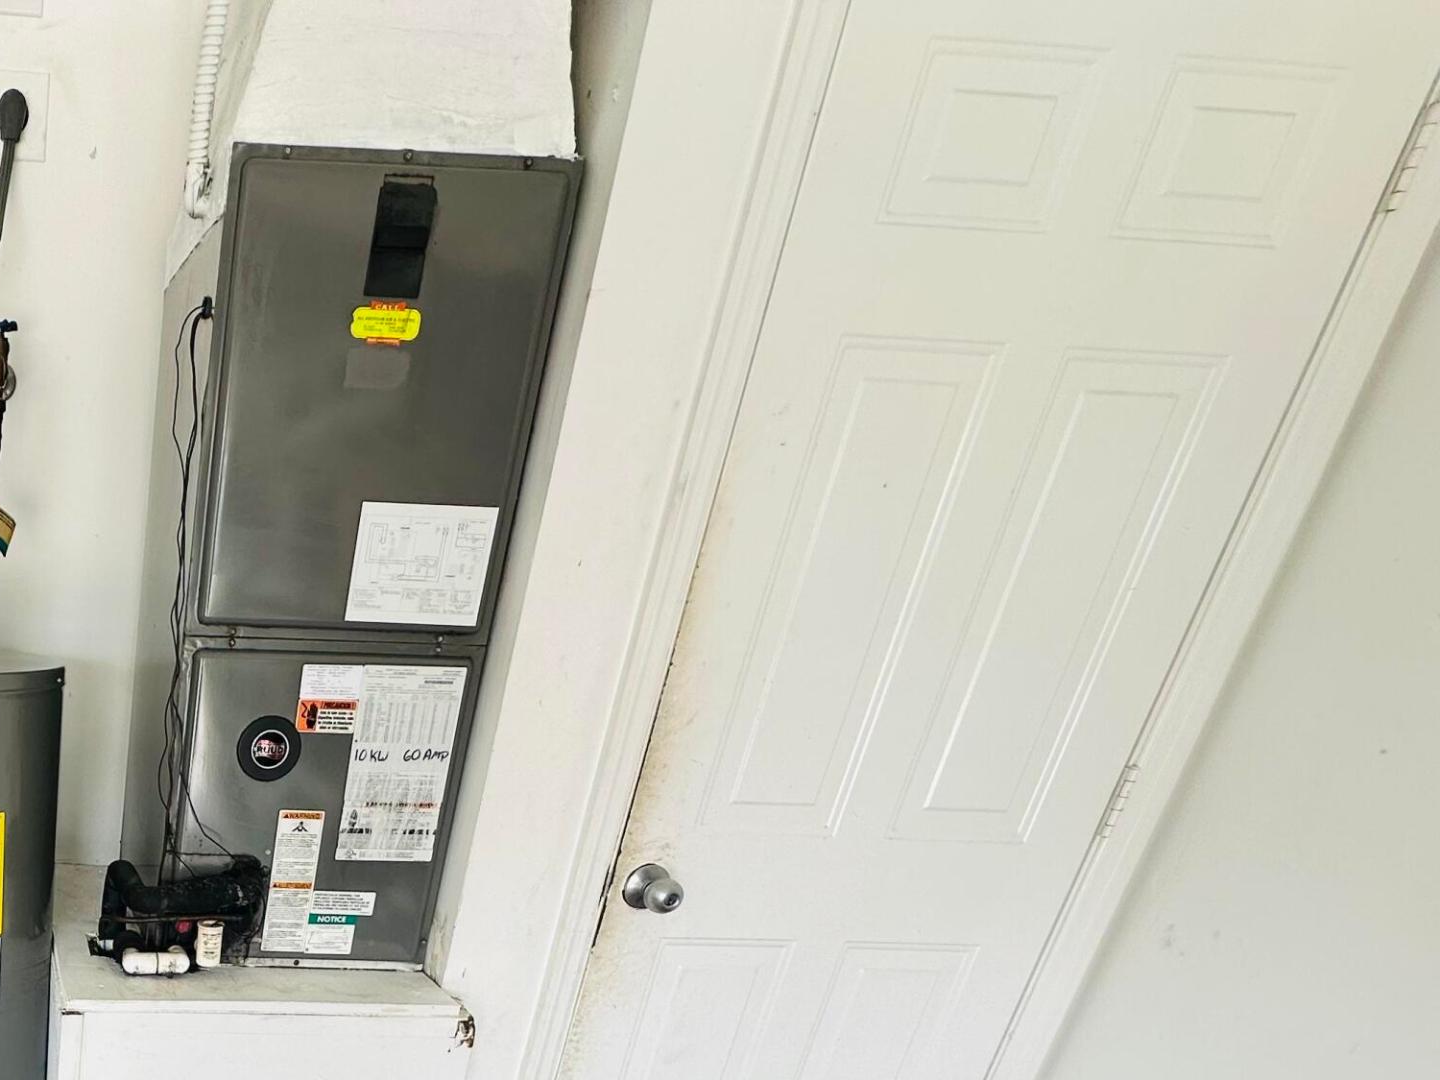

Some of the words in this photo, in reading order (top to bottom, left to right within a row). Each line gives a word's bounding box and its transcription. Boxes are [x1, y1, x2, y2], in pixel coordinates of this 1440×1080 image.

[354, 749, 364, 761] 10
[403, 749, 420, 761] 60
[317, 915, 347, 923] NOTICE
